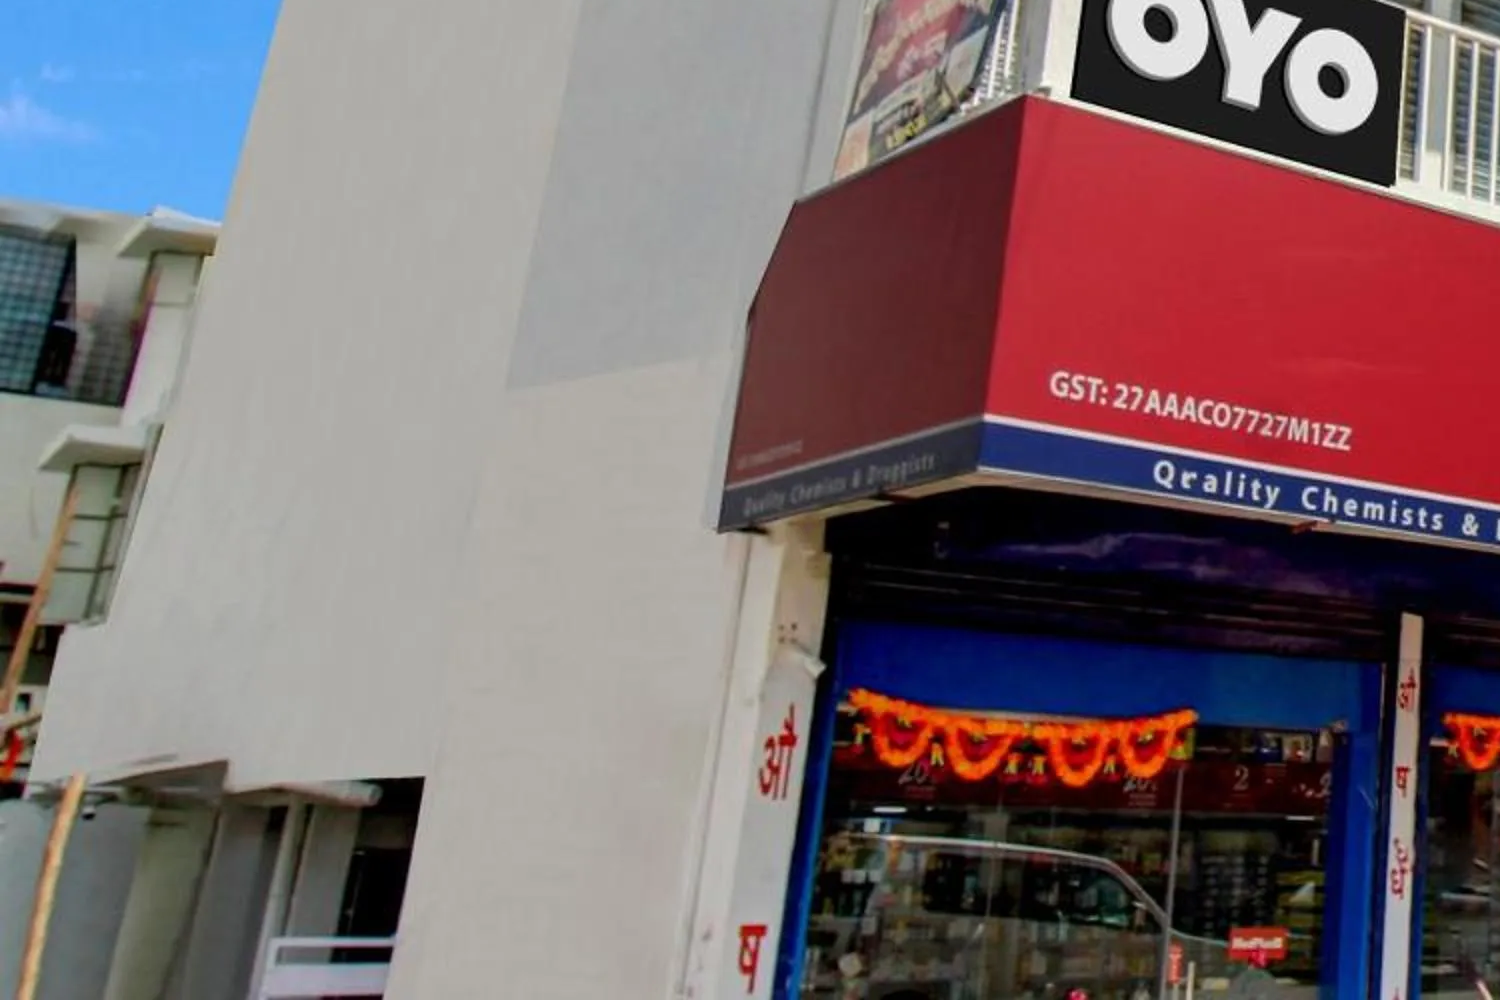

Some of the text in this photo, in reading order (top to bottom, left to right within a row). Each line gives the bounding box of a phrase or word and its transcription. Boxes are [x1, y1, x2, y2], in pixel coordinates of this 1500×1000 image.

[1049, 369, 1109, 407] GST:
[1301, 484, 1444, 531] Chemists
[1461, 512, 1481, 537] &
